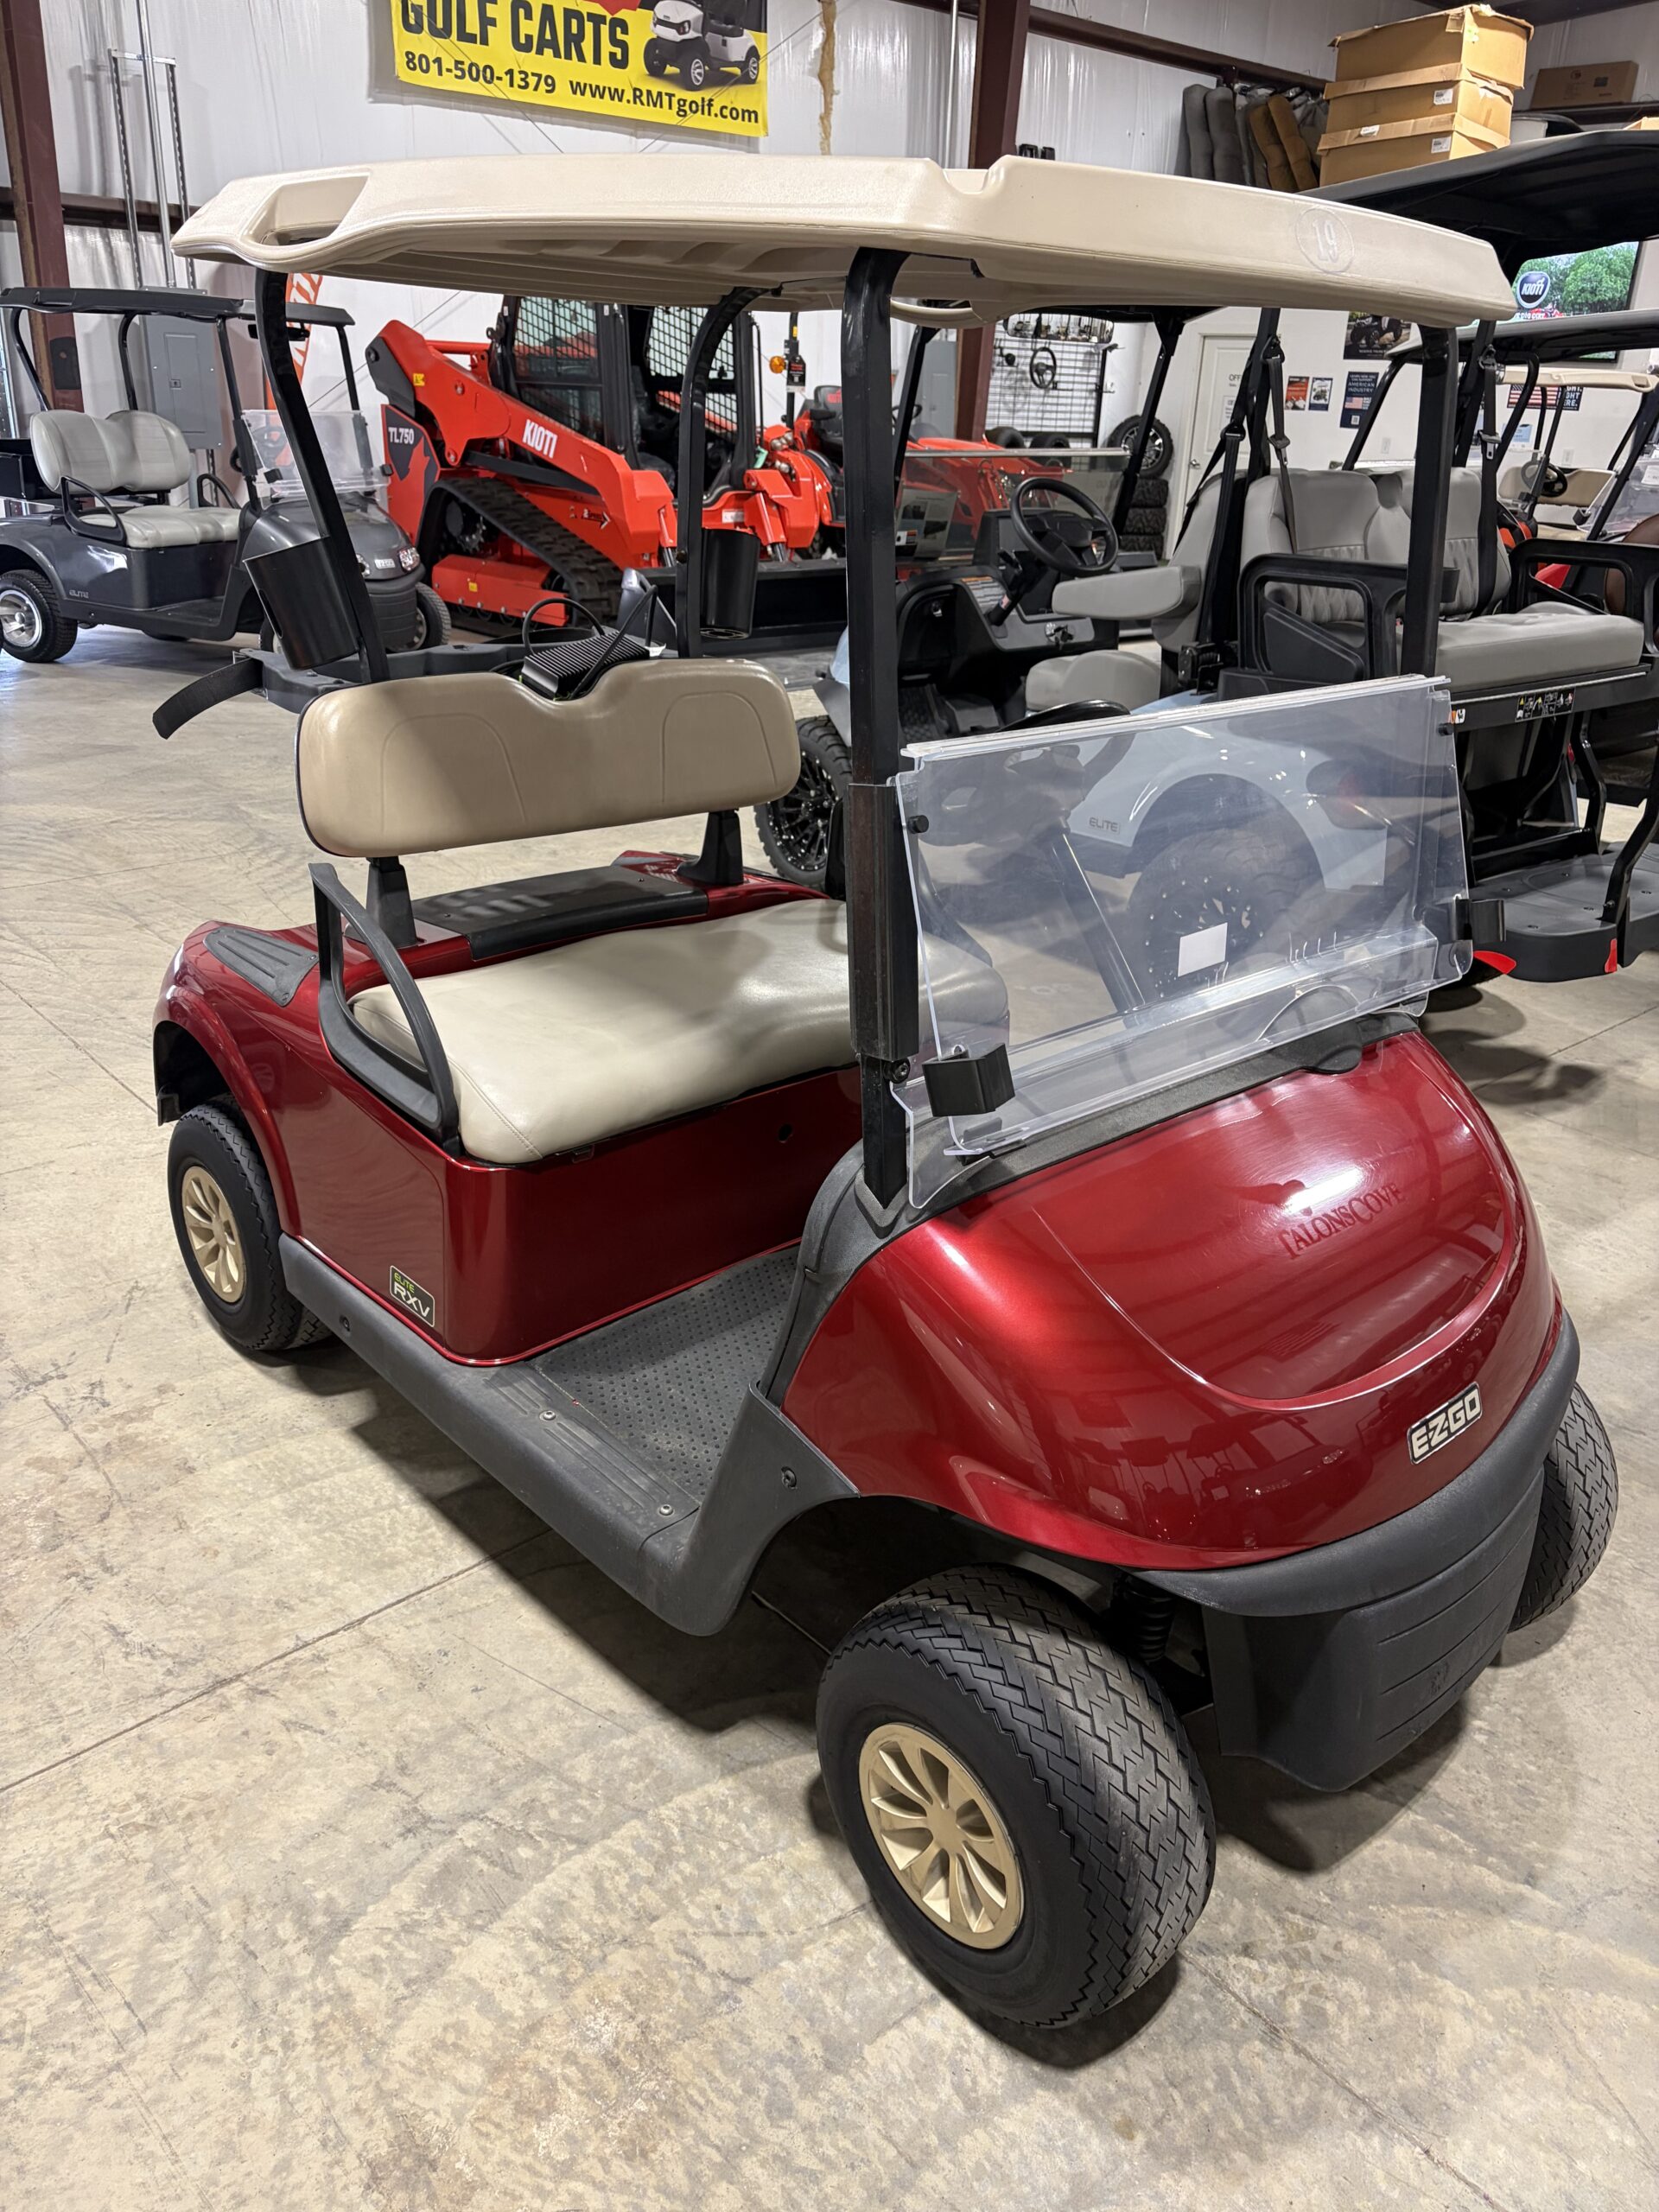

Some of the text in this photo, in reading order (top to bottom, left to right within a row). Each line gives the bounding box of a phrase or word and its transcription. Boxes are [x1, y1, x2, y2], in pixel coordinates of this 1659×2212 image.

[401, 0, 630, 70] GOLF CARTS
[404, 50, 759, 124] 801-500-1379 www.RMTgolf.com
[388, 427, 415, 445] TL750
[522, 419, 558, 460] KIOTI
[1089, 817, 1118, 833] ELITE
[393, 1281, 430, 1317] RXV
[394, 1272, 415, 1294] ELITE
